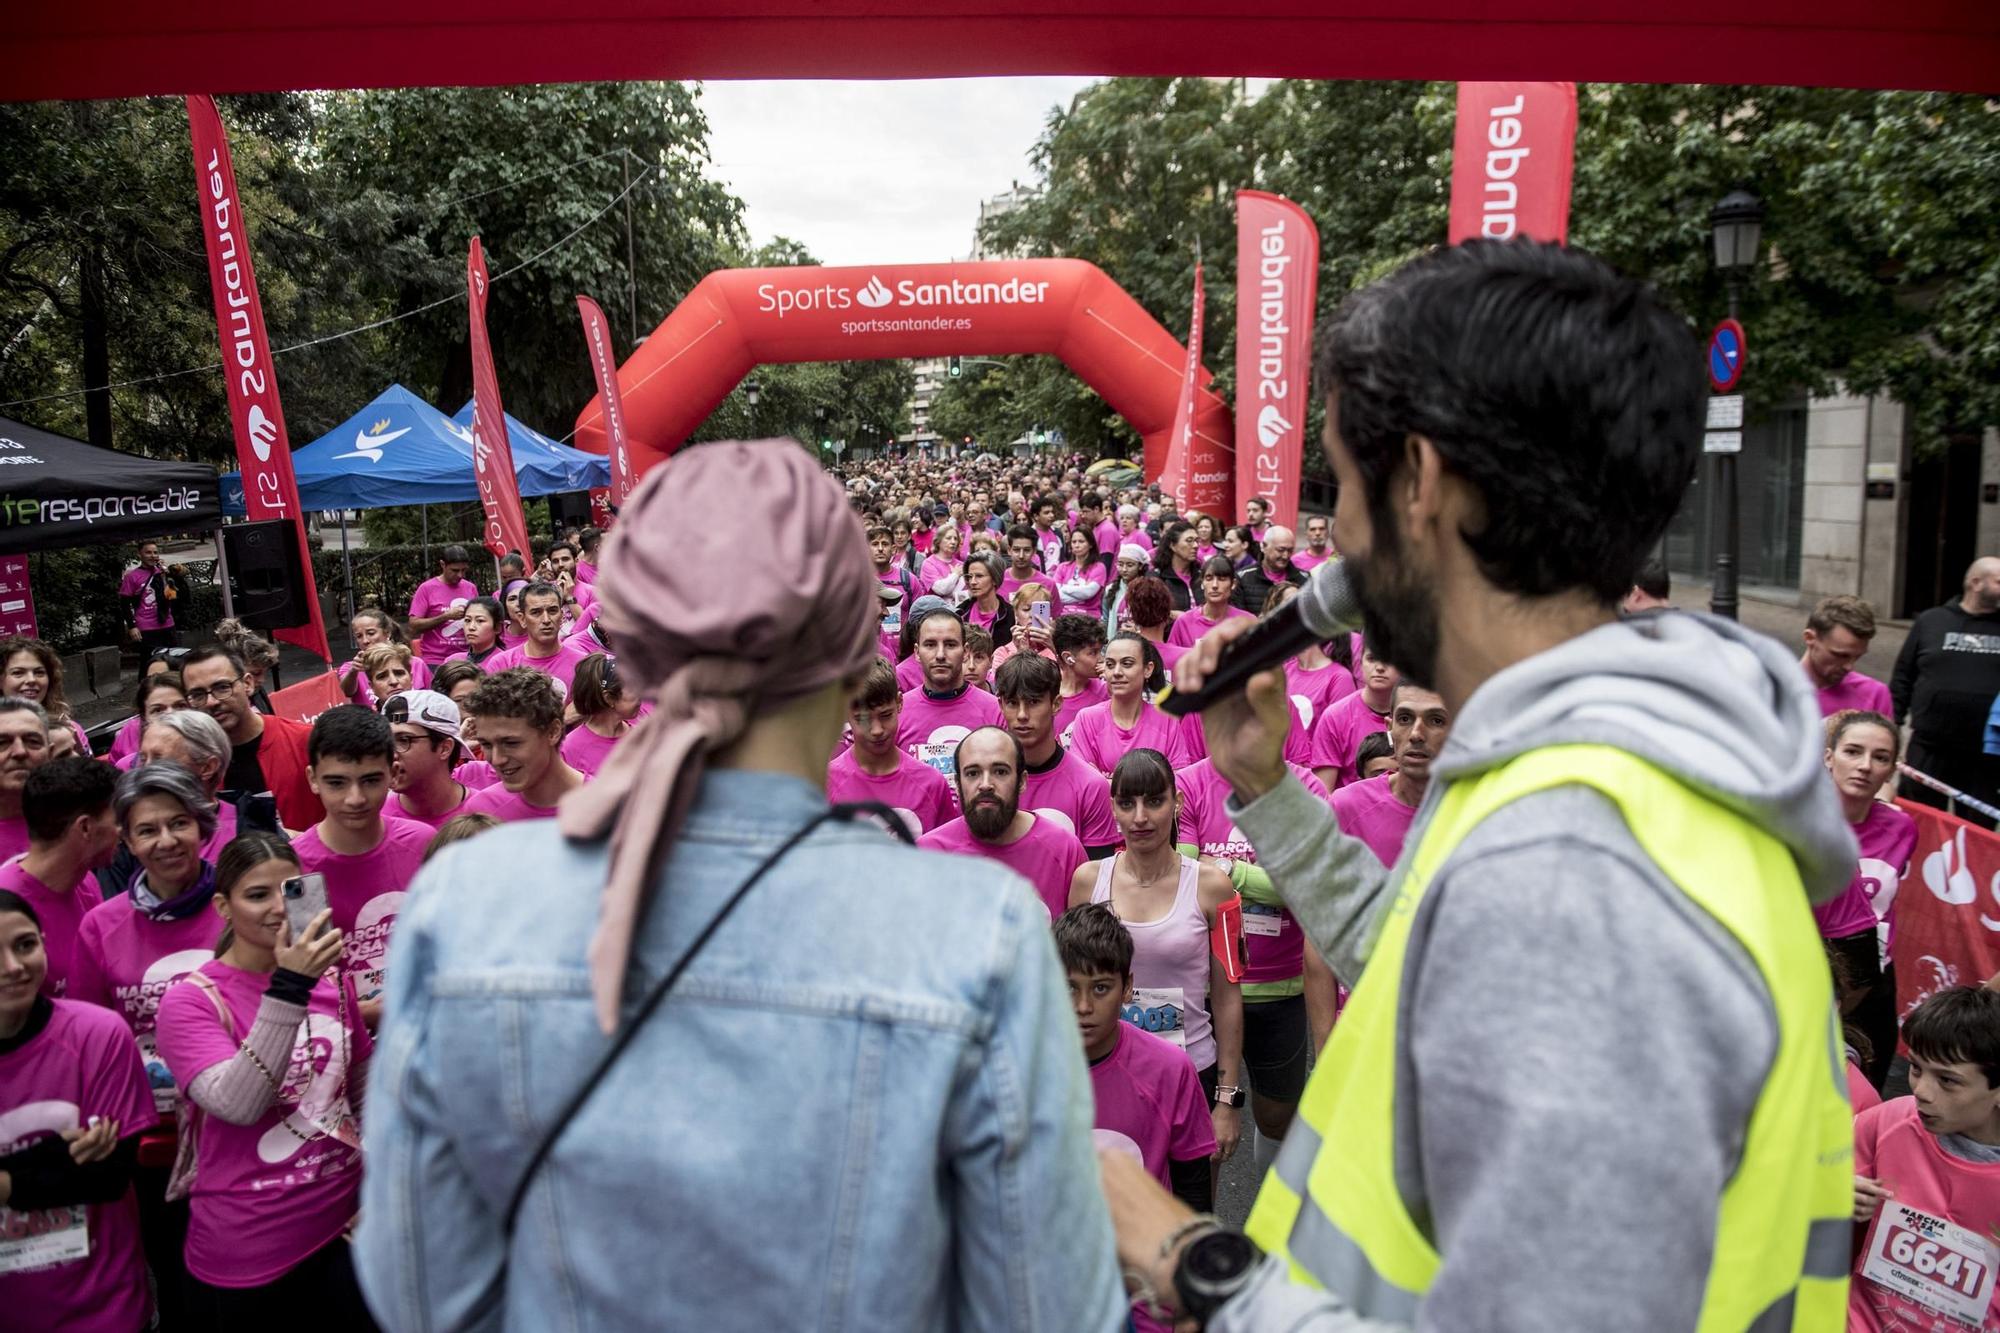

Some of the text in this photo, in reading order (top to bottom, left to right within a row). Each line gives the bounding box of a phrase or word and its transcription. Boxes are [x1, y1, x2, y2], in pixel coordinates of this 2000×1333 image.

[758, 277, 1050, 318] Sports Santander
[841, 316, 972, 335] sportssantander.es
[1192, 453, 1216, 464] orts
[1191, 471, 1230, 484] tander
[2, 486, 200, 527] teresponsable
[1203, 841, 1255, 854] MARCH
[1120, 1004, 1177, 1032] 003
[1899, 1207, 1947, 1230] MARCHA
[1890, 1231, 1982, 1296] 6641
